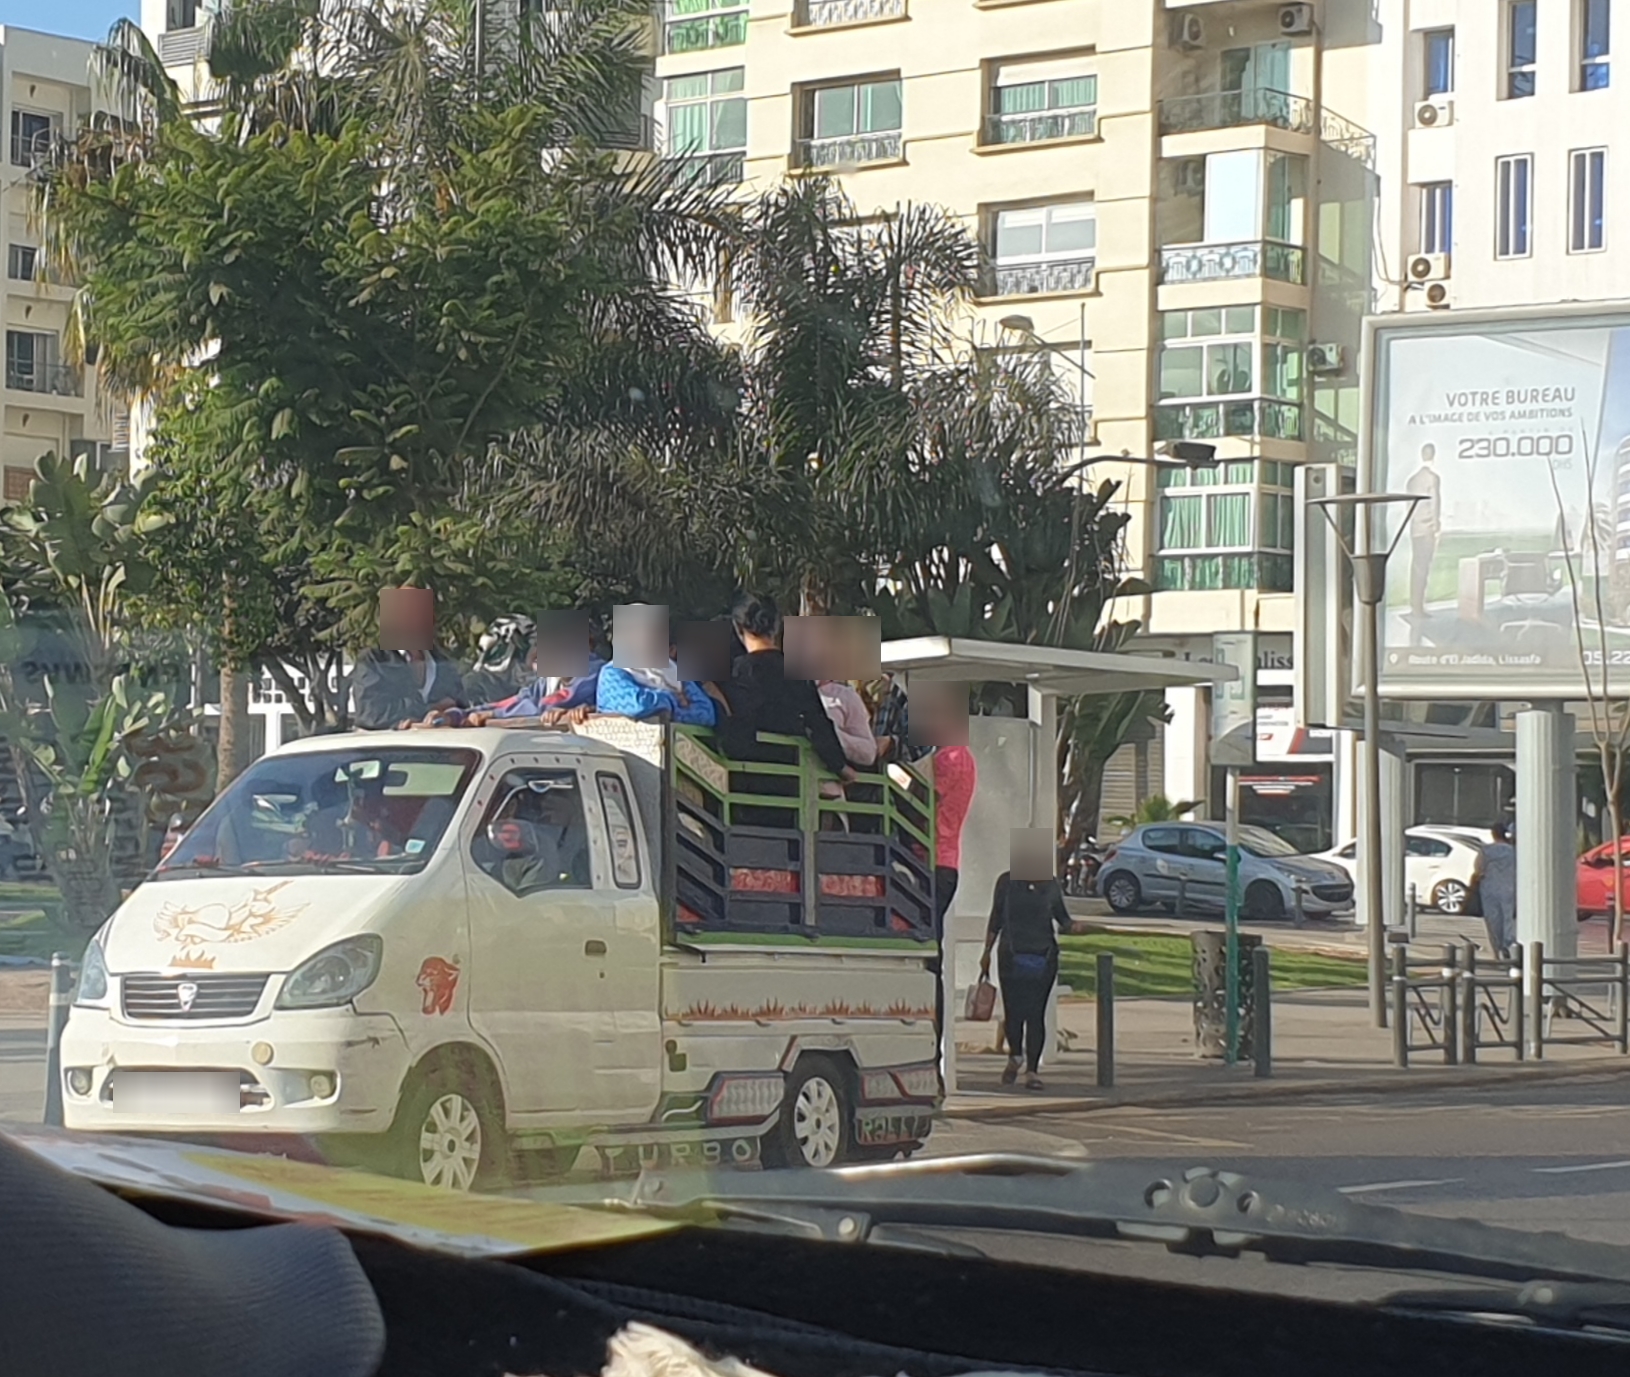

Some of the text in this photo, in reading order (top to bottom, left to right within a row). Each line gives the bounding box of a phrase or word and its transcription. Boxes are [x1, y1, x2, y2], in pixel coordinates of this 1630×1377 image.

[1446, 387, 1575, 408] VOTRE BUREAU
[1466, 410, 1480, 423] DE
[1483, 410, 1506, 422] VOS
[1509, 407, 1573, 421] AMBITIONS
[1458, 434, 1574, 459] 230.000
